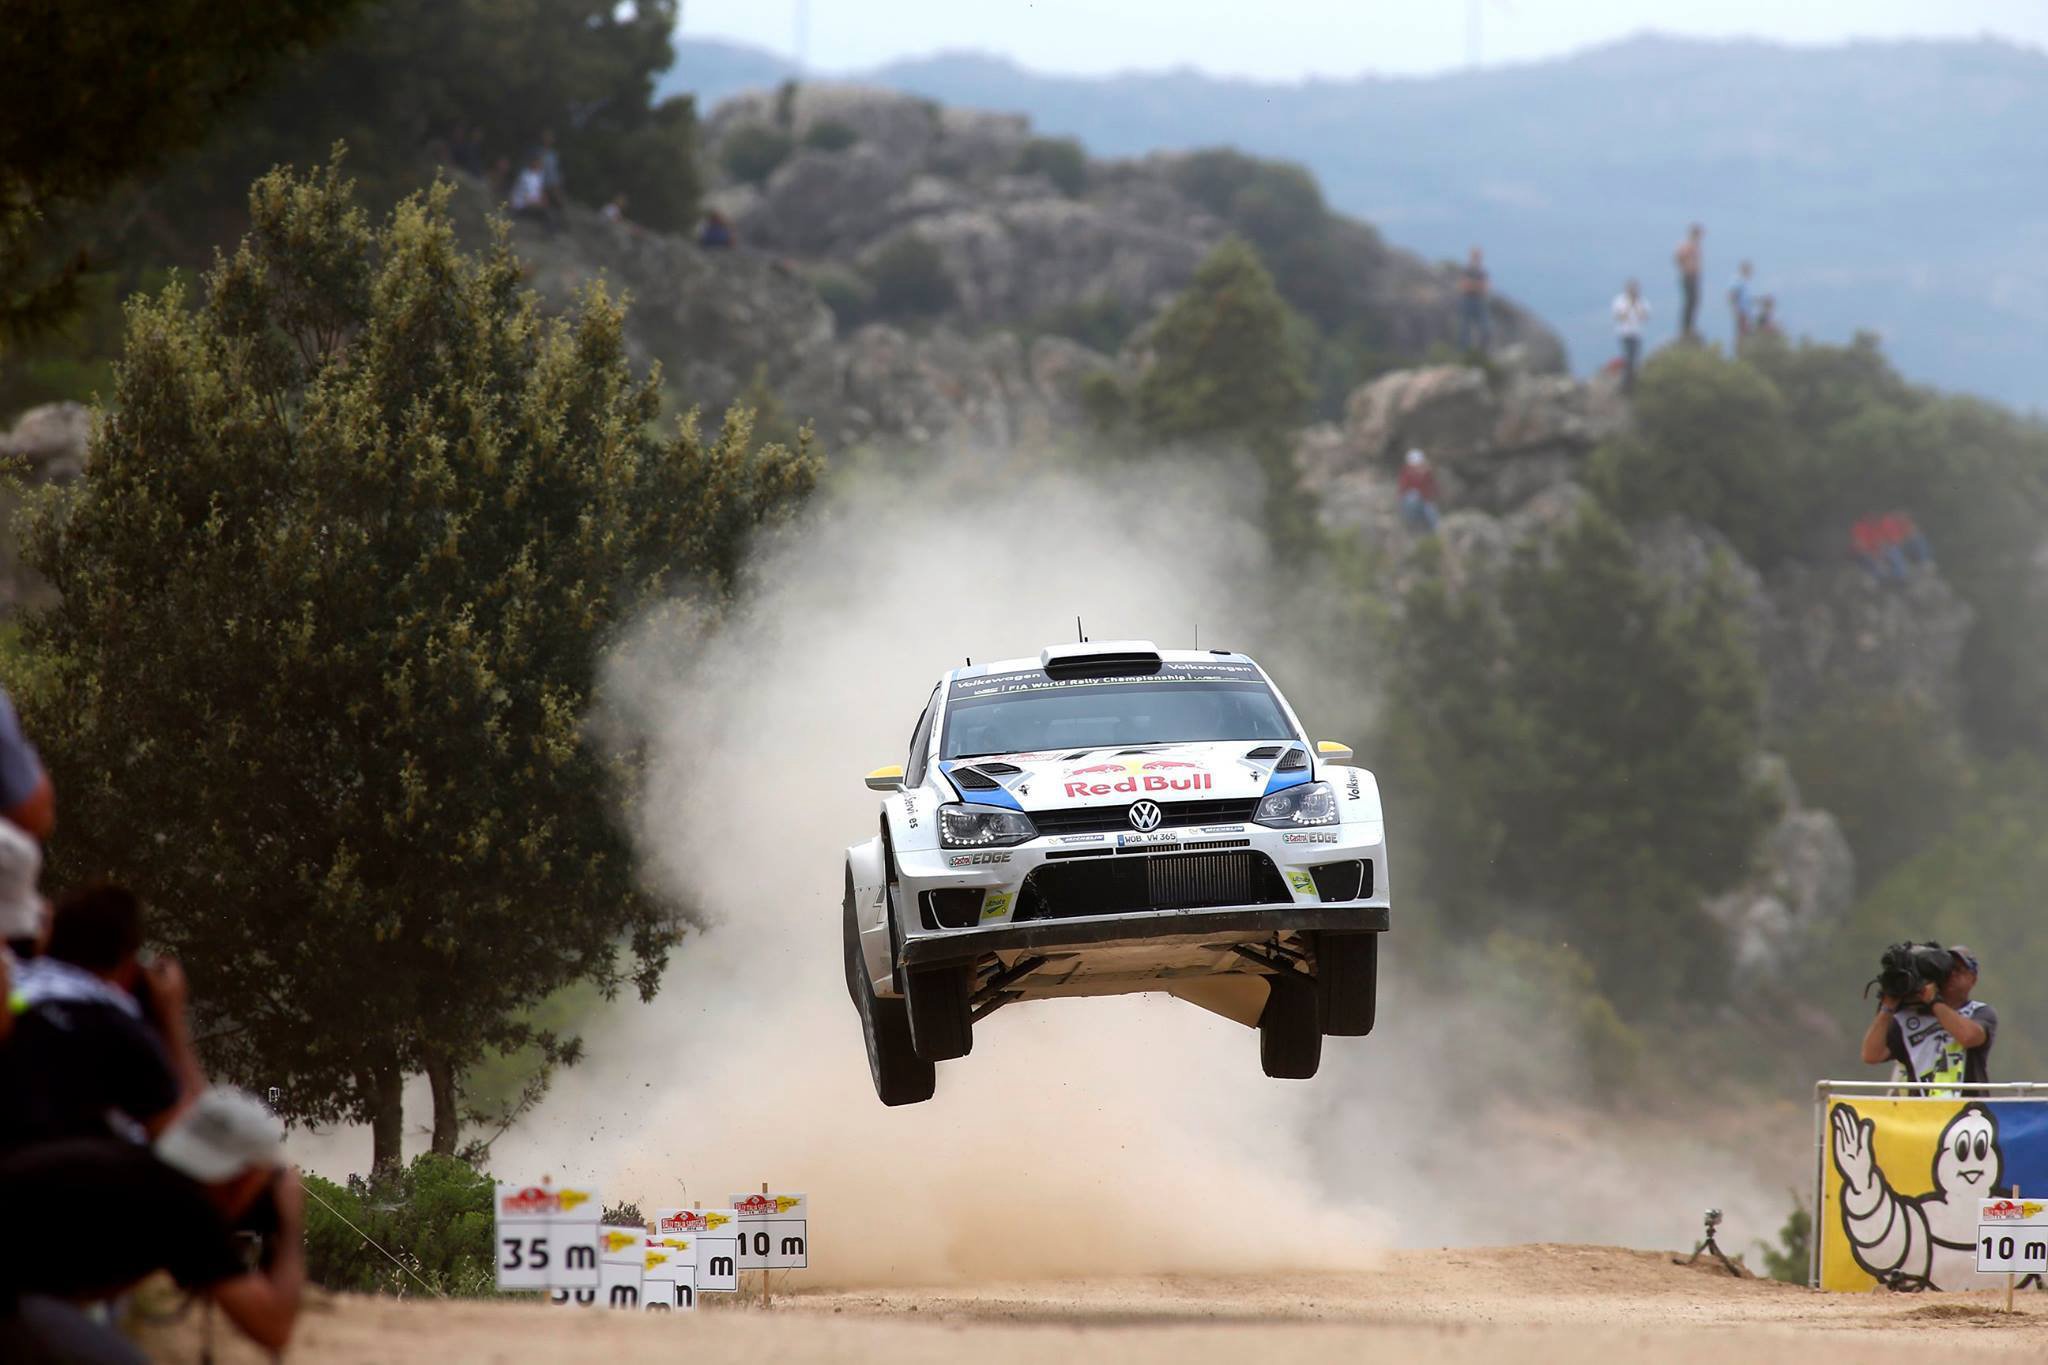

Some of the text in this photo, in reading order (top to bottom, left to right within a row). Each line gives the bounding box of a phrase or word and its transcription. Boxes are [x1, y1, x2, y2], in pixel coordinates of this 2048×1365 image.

[1167, 664, 1252, 672] Volkswagen
[957, 673, 1041, 688] Volkswagen
[1031, 680, 1066, 688] World
[1069, 677, 1100, 686] Rally
[1103, 673, 1186, 682] Championship
[1064, 773, 1212, 798] Red Bull
[1125, 835, 1143, 843] WOB
[1160, 833, 1176, 841] 365
[1309, 832, 1338, 843] EDGE
[972, 852, 1013, 864] EDGE
[737, 1231, 804, 1256] 10 m
[1981, 1236, 2046, 1260] 10 m
[503, 1238, 595, 1270] 35 m
[710, 1257, 733, 1275] m
[609, 1285, 637, 1309] m
